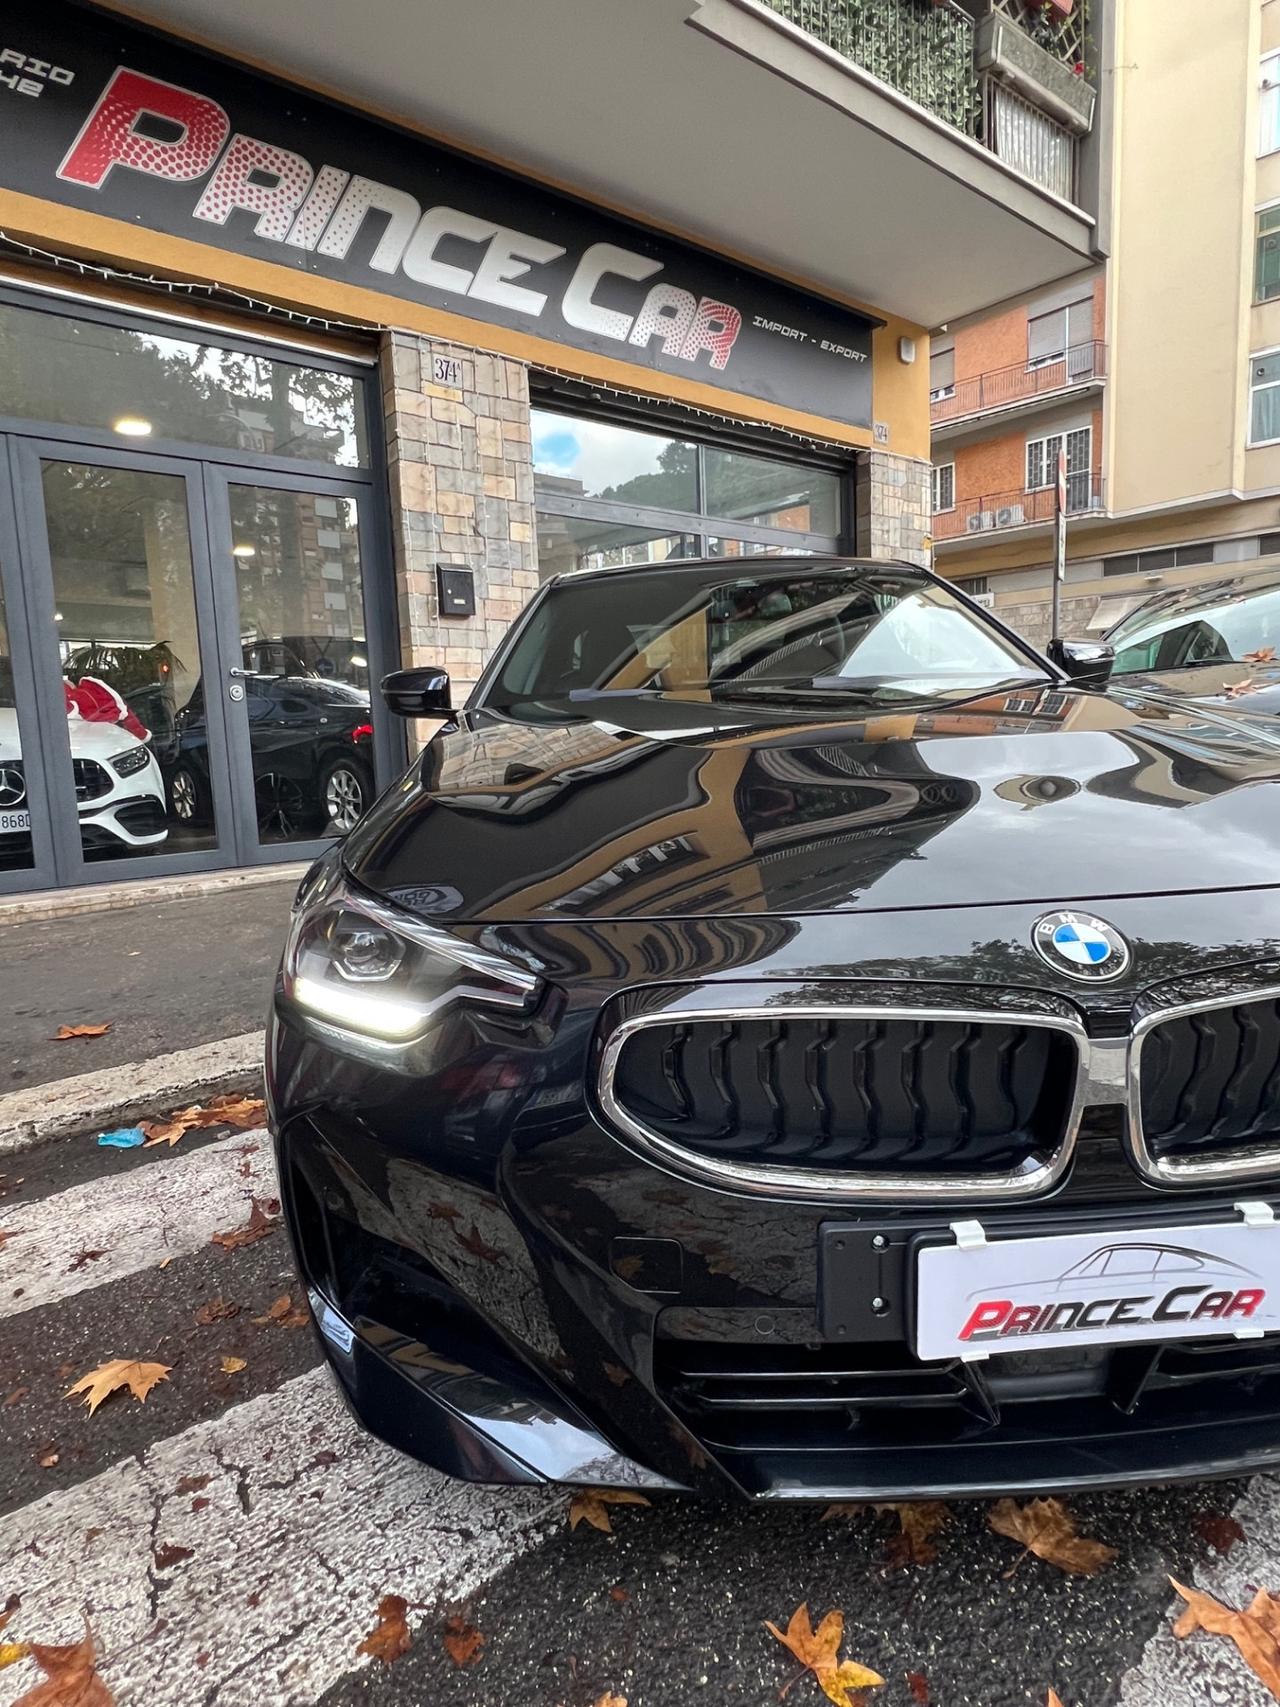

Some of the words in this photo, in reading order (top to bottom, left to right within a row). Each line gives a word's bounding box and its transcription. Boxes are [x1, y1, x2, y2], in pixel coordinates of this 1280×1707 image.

[56, 64, 567, 317] PRINCE
[561, 241, 742, 370] CAR
[752, 315, 808, 342] IMPORT
[820, 340, 868, 363] EXPORT
[1038, 913, 1110, 936] BMW
[957, 1295, 1155, 1341] PRINCE
[1152, 1284, 1266, 1323] CAR
